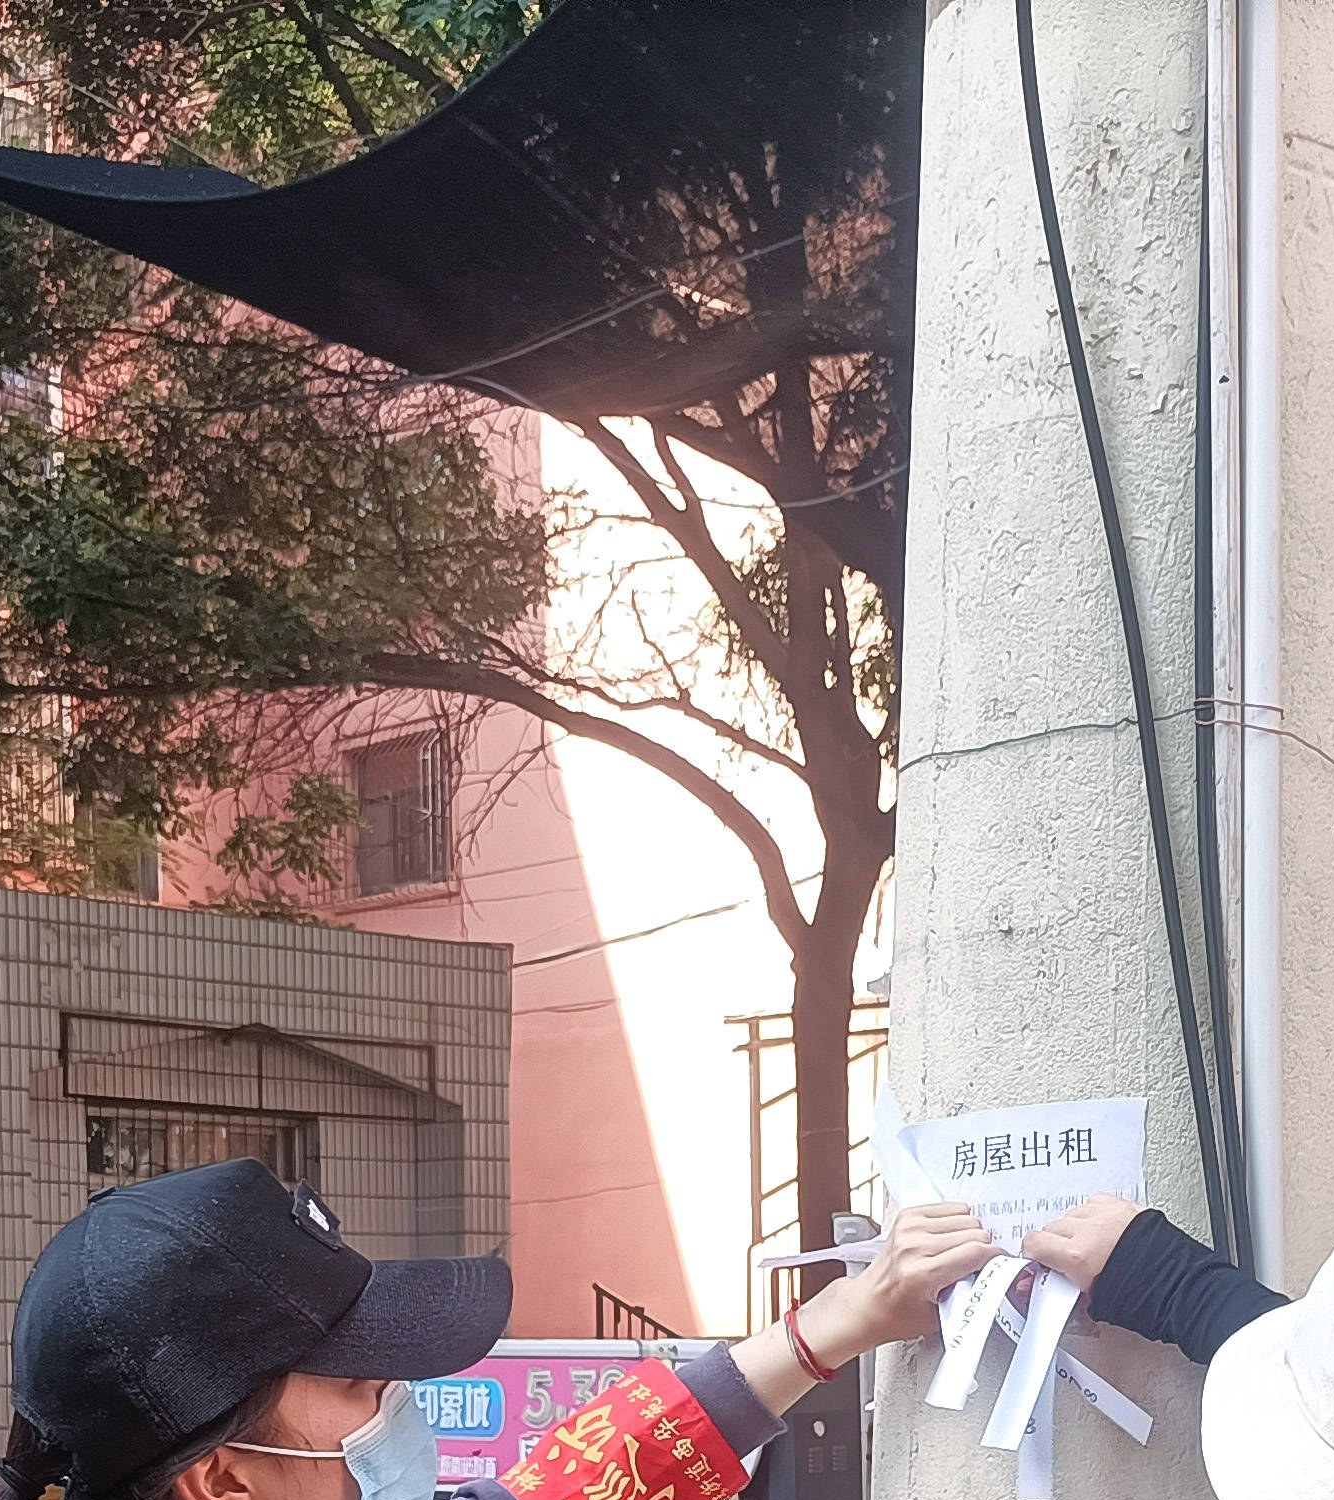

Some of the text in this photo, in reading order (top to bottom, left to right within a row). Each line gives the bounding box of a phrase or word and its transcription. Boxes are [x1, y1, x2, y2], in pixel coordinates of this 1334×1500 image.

[951, 1127, 1098, 1180] 房屋出租
[415, 1384, 490, 1429] 印象城
